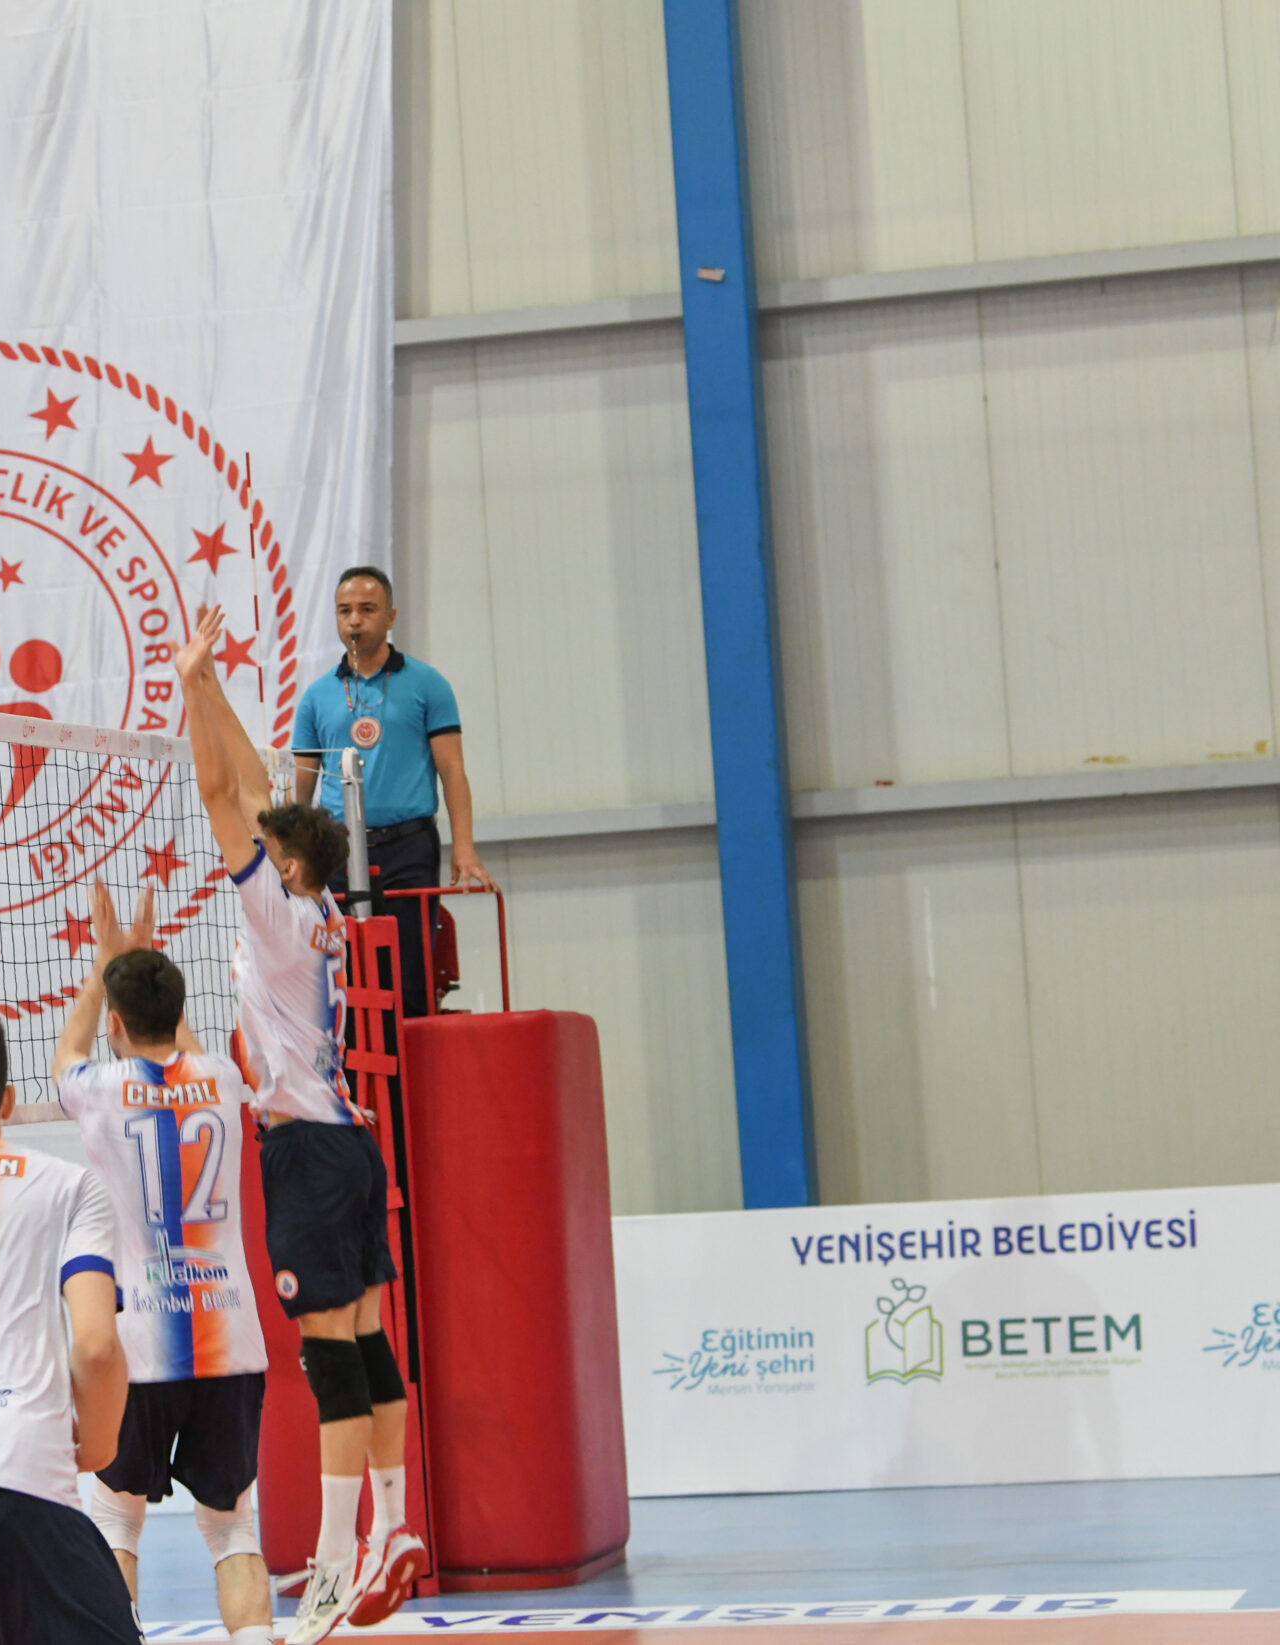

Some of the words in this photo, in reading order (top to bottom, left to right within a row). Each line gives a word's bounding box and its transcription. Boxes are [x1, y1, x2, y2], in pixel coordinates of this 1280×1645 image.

[78, 505, 128, 558] VE
[116, 556, 170, 668] SPOR
[29, 680, 174, 881] BAANLIĞI
[126, 1080, 217, 1107] CEMAL
[124, 1109, 228, 1227] 12
[791, 1219, 981, 1266] YENİŞEHİR
[992, 1209, 1197, 1256] BELEDİYESİ
[701, 1325, 814, 1359] Eğitimin
[961, 1314, 1142, 1357] BETEM
[685, 1351, 749, 1391] Yeni
[755, 1353, 814, 1381] şehri
[422, 1595, 1122, 1628] YENİŞEHİR
